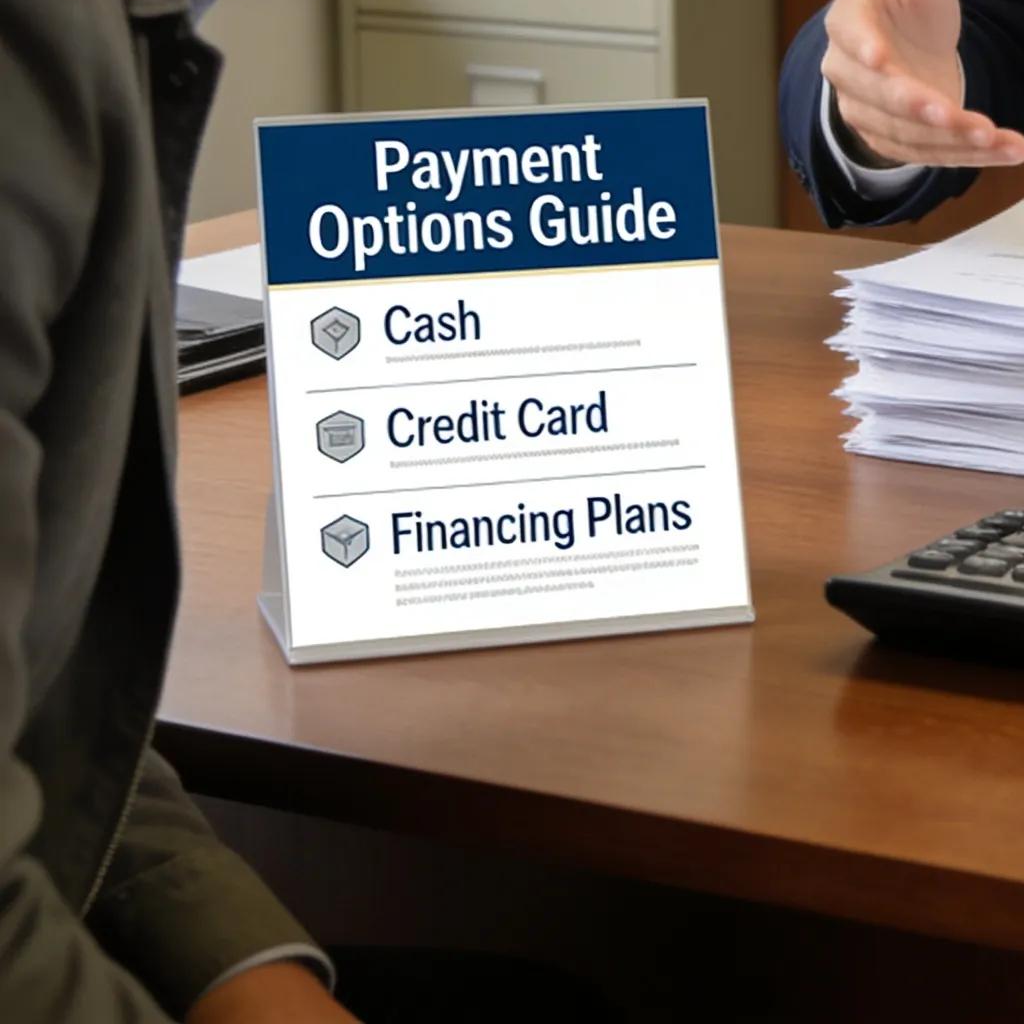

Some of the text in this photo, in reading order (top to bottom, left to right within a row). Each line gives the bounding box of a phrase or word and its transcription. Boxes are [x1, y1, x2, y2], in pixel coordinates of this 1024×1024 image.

[373, 133, 604, 202] Payment
[308, 187, 677, 271] Options Guide
[384, 300, 482, 345] Cash
[387, 390, 609, 448] Credit Card
[391, 493, 693, 554] Financing Plans
